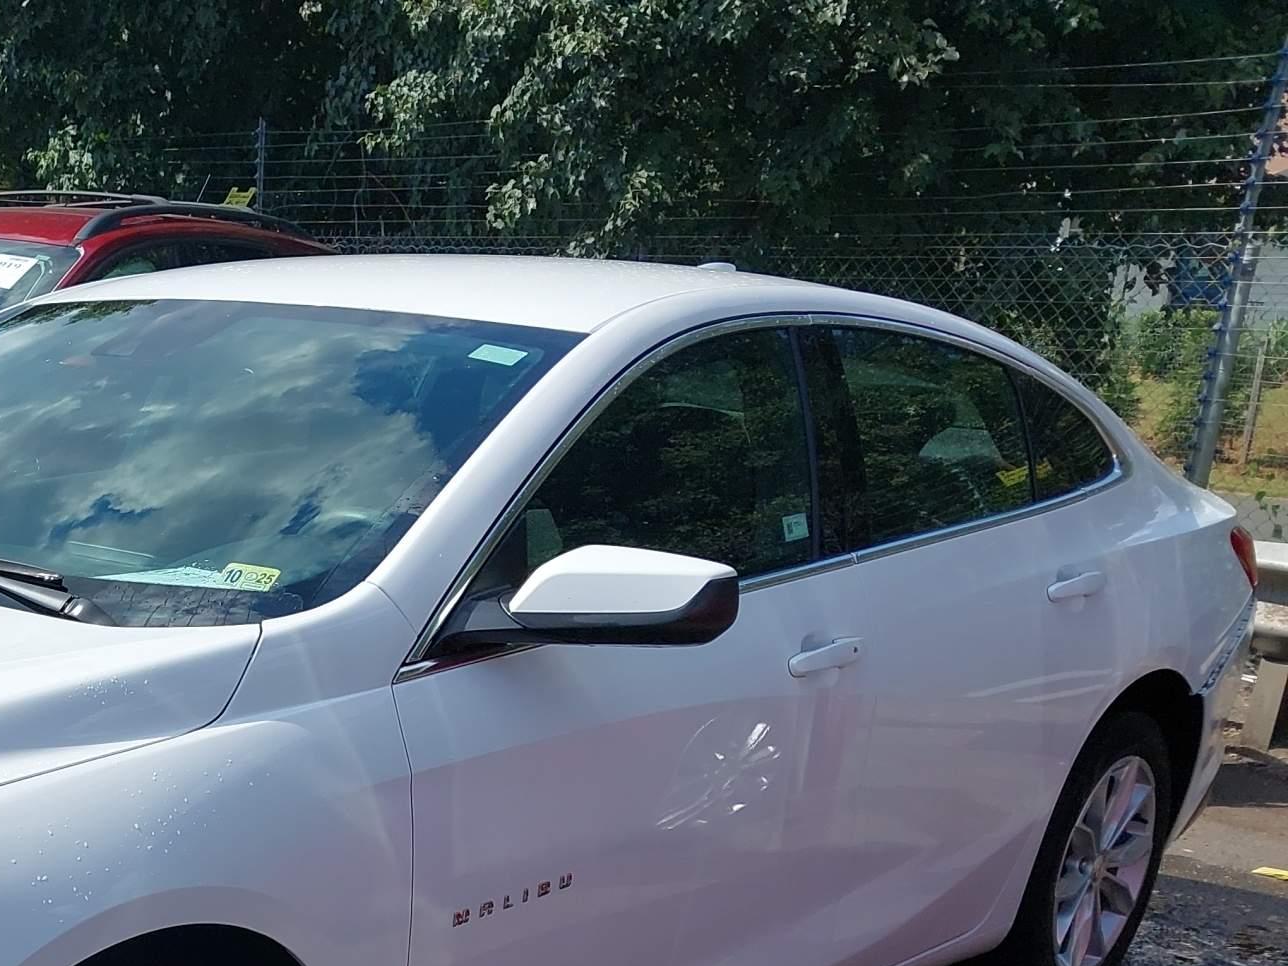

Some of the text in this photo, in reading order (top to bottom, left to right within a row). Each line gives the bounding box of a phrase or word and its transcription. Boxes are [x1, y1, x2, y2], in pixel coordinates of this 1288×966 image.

[224, 569, 275, 584] 10 25
[452, 872, 573, 928] MALIBU
